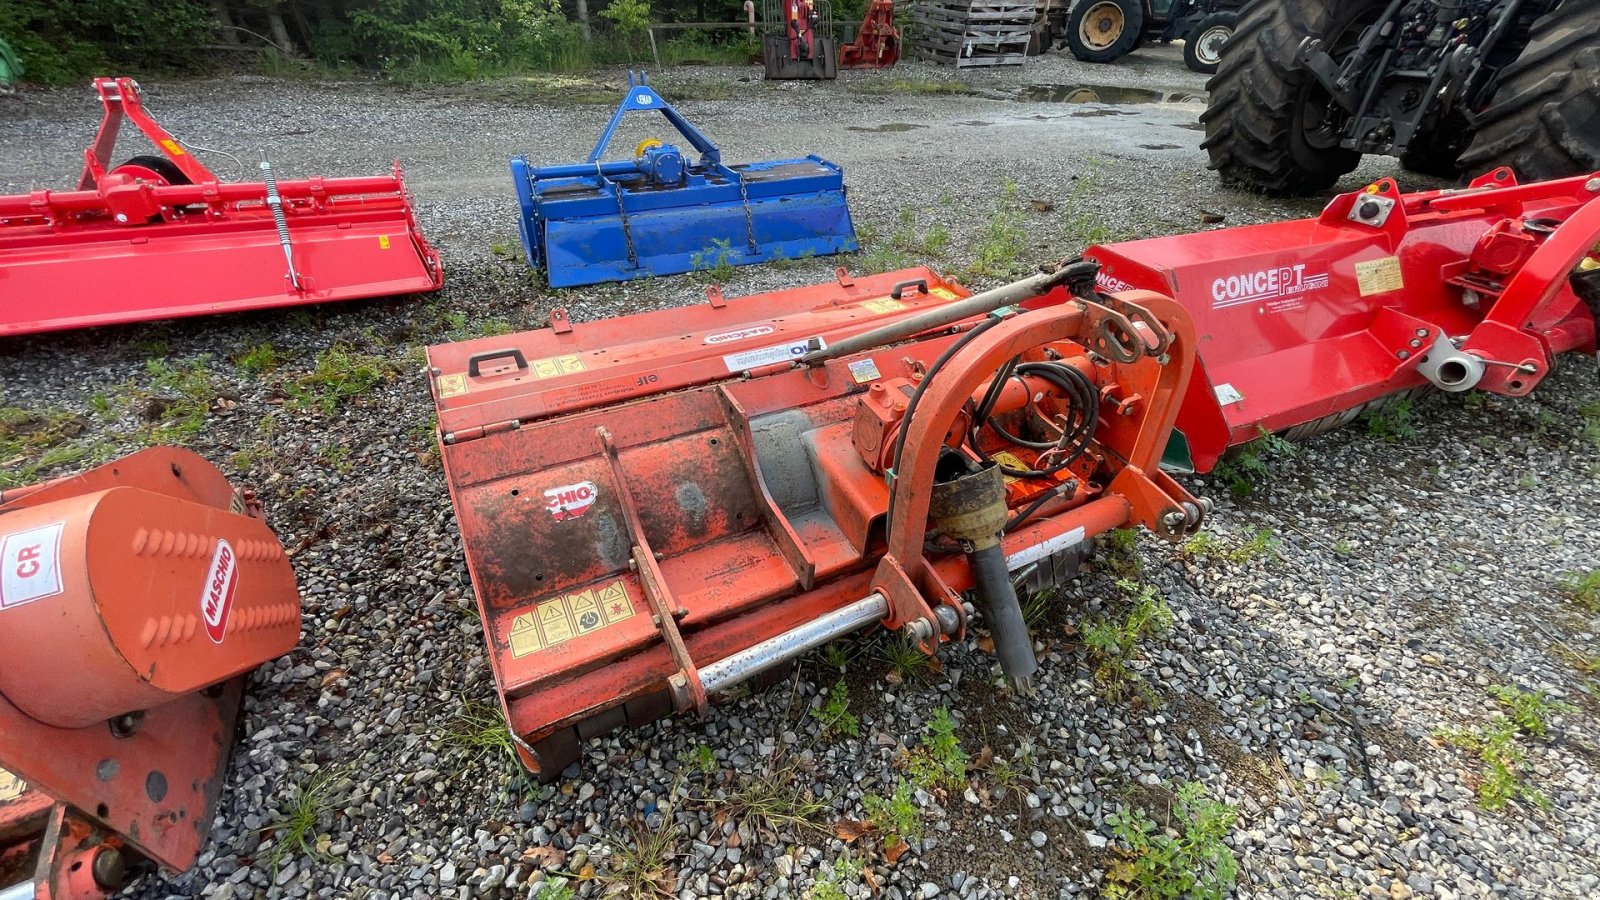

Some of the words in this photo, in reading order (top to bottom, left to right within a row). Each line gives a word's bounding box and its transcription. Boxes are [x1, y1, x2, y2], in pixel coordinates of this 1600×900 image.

[1212, 264, 1306, 301] CONCEPT
[636, 374, 658, 386] elf
[17, 544, 41, 579] CR
[205, 546, 232, 621] MASCHIO
